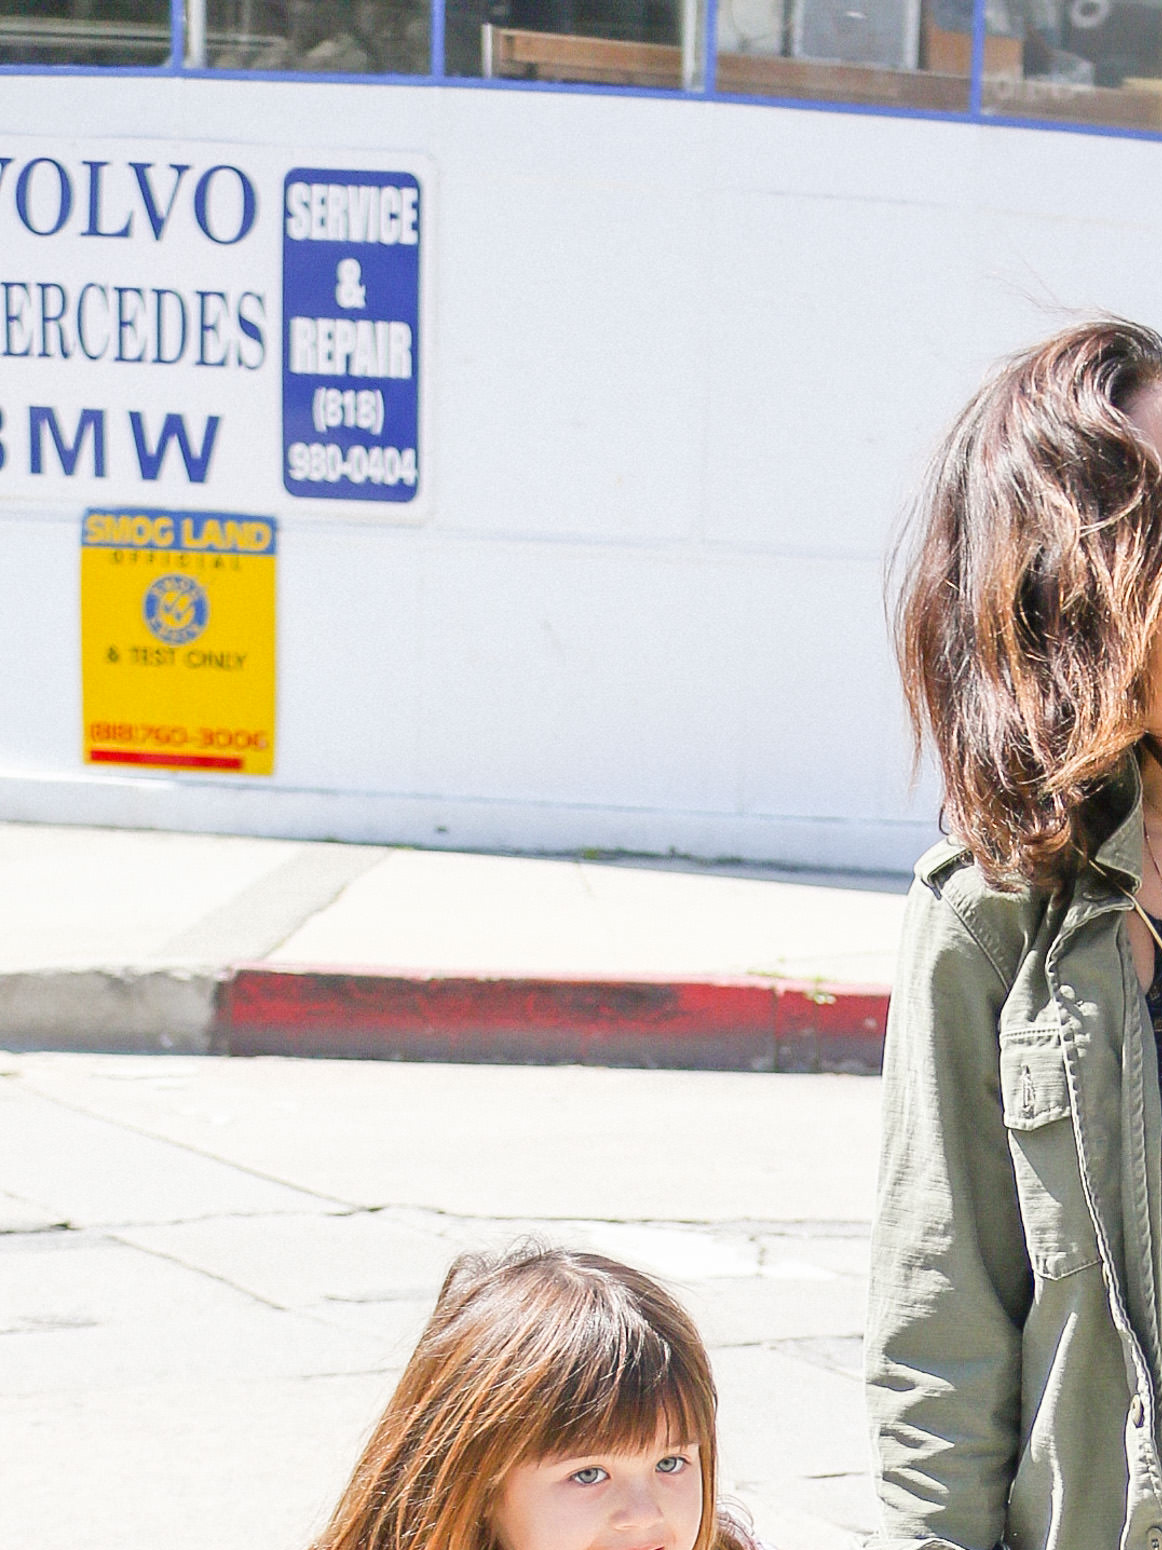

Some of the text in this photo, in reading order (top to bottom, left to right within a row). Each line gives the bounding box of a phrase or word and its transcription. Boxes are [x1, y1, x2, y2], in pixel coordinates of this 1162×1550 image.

[286, 181, 419, 245] SERVICE
[335, 257, 367, 309] &
[0, 282, 266, 370] ERCEDES
[289, 316, 413, 380] REPAIR
[312, 387, 385, 435] (818)
[0, 404, 221, 484] MW
[84, 513, 272, 552] SMOG LAND
